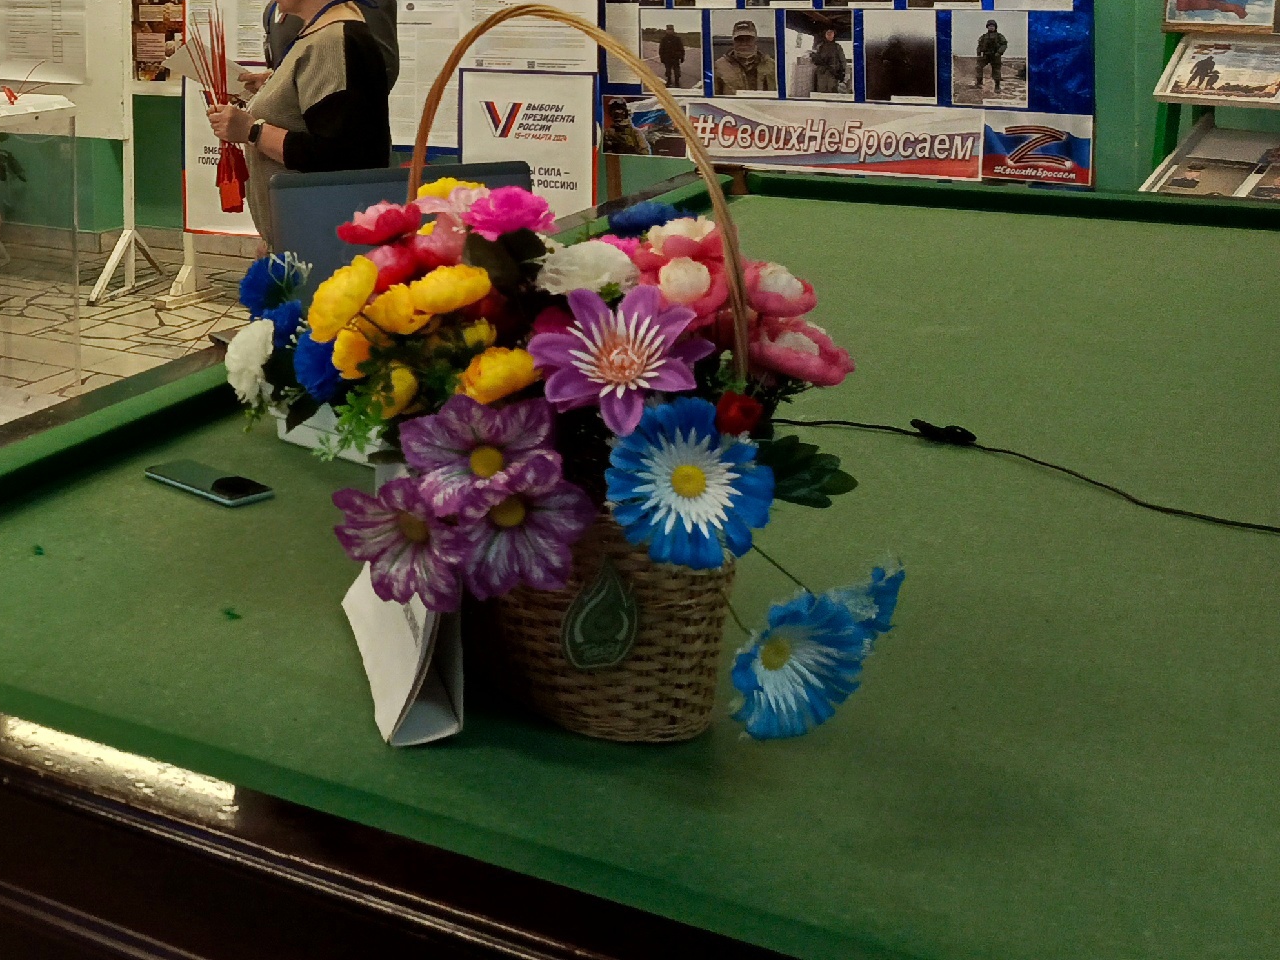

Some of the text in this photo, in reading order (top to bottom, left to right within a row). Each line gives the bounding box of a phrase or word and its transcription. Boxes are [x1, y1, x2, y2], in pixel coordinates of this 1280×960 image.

[525, 103, 565, 112] ВЫБОРЫ
[521, 113, 576, 124] ПРЕЗИДЕНТА
[516, 123, 552, 132] РОССИИ
[693, 113, 977, 163] #СвоихНеБросаем
[538, 167, 561, 177] СИЛА
[993, 165, 1076, 180] #СвоихНеБросаем
[537, 178, 578, 190] РОССИЮ!
